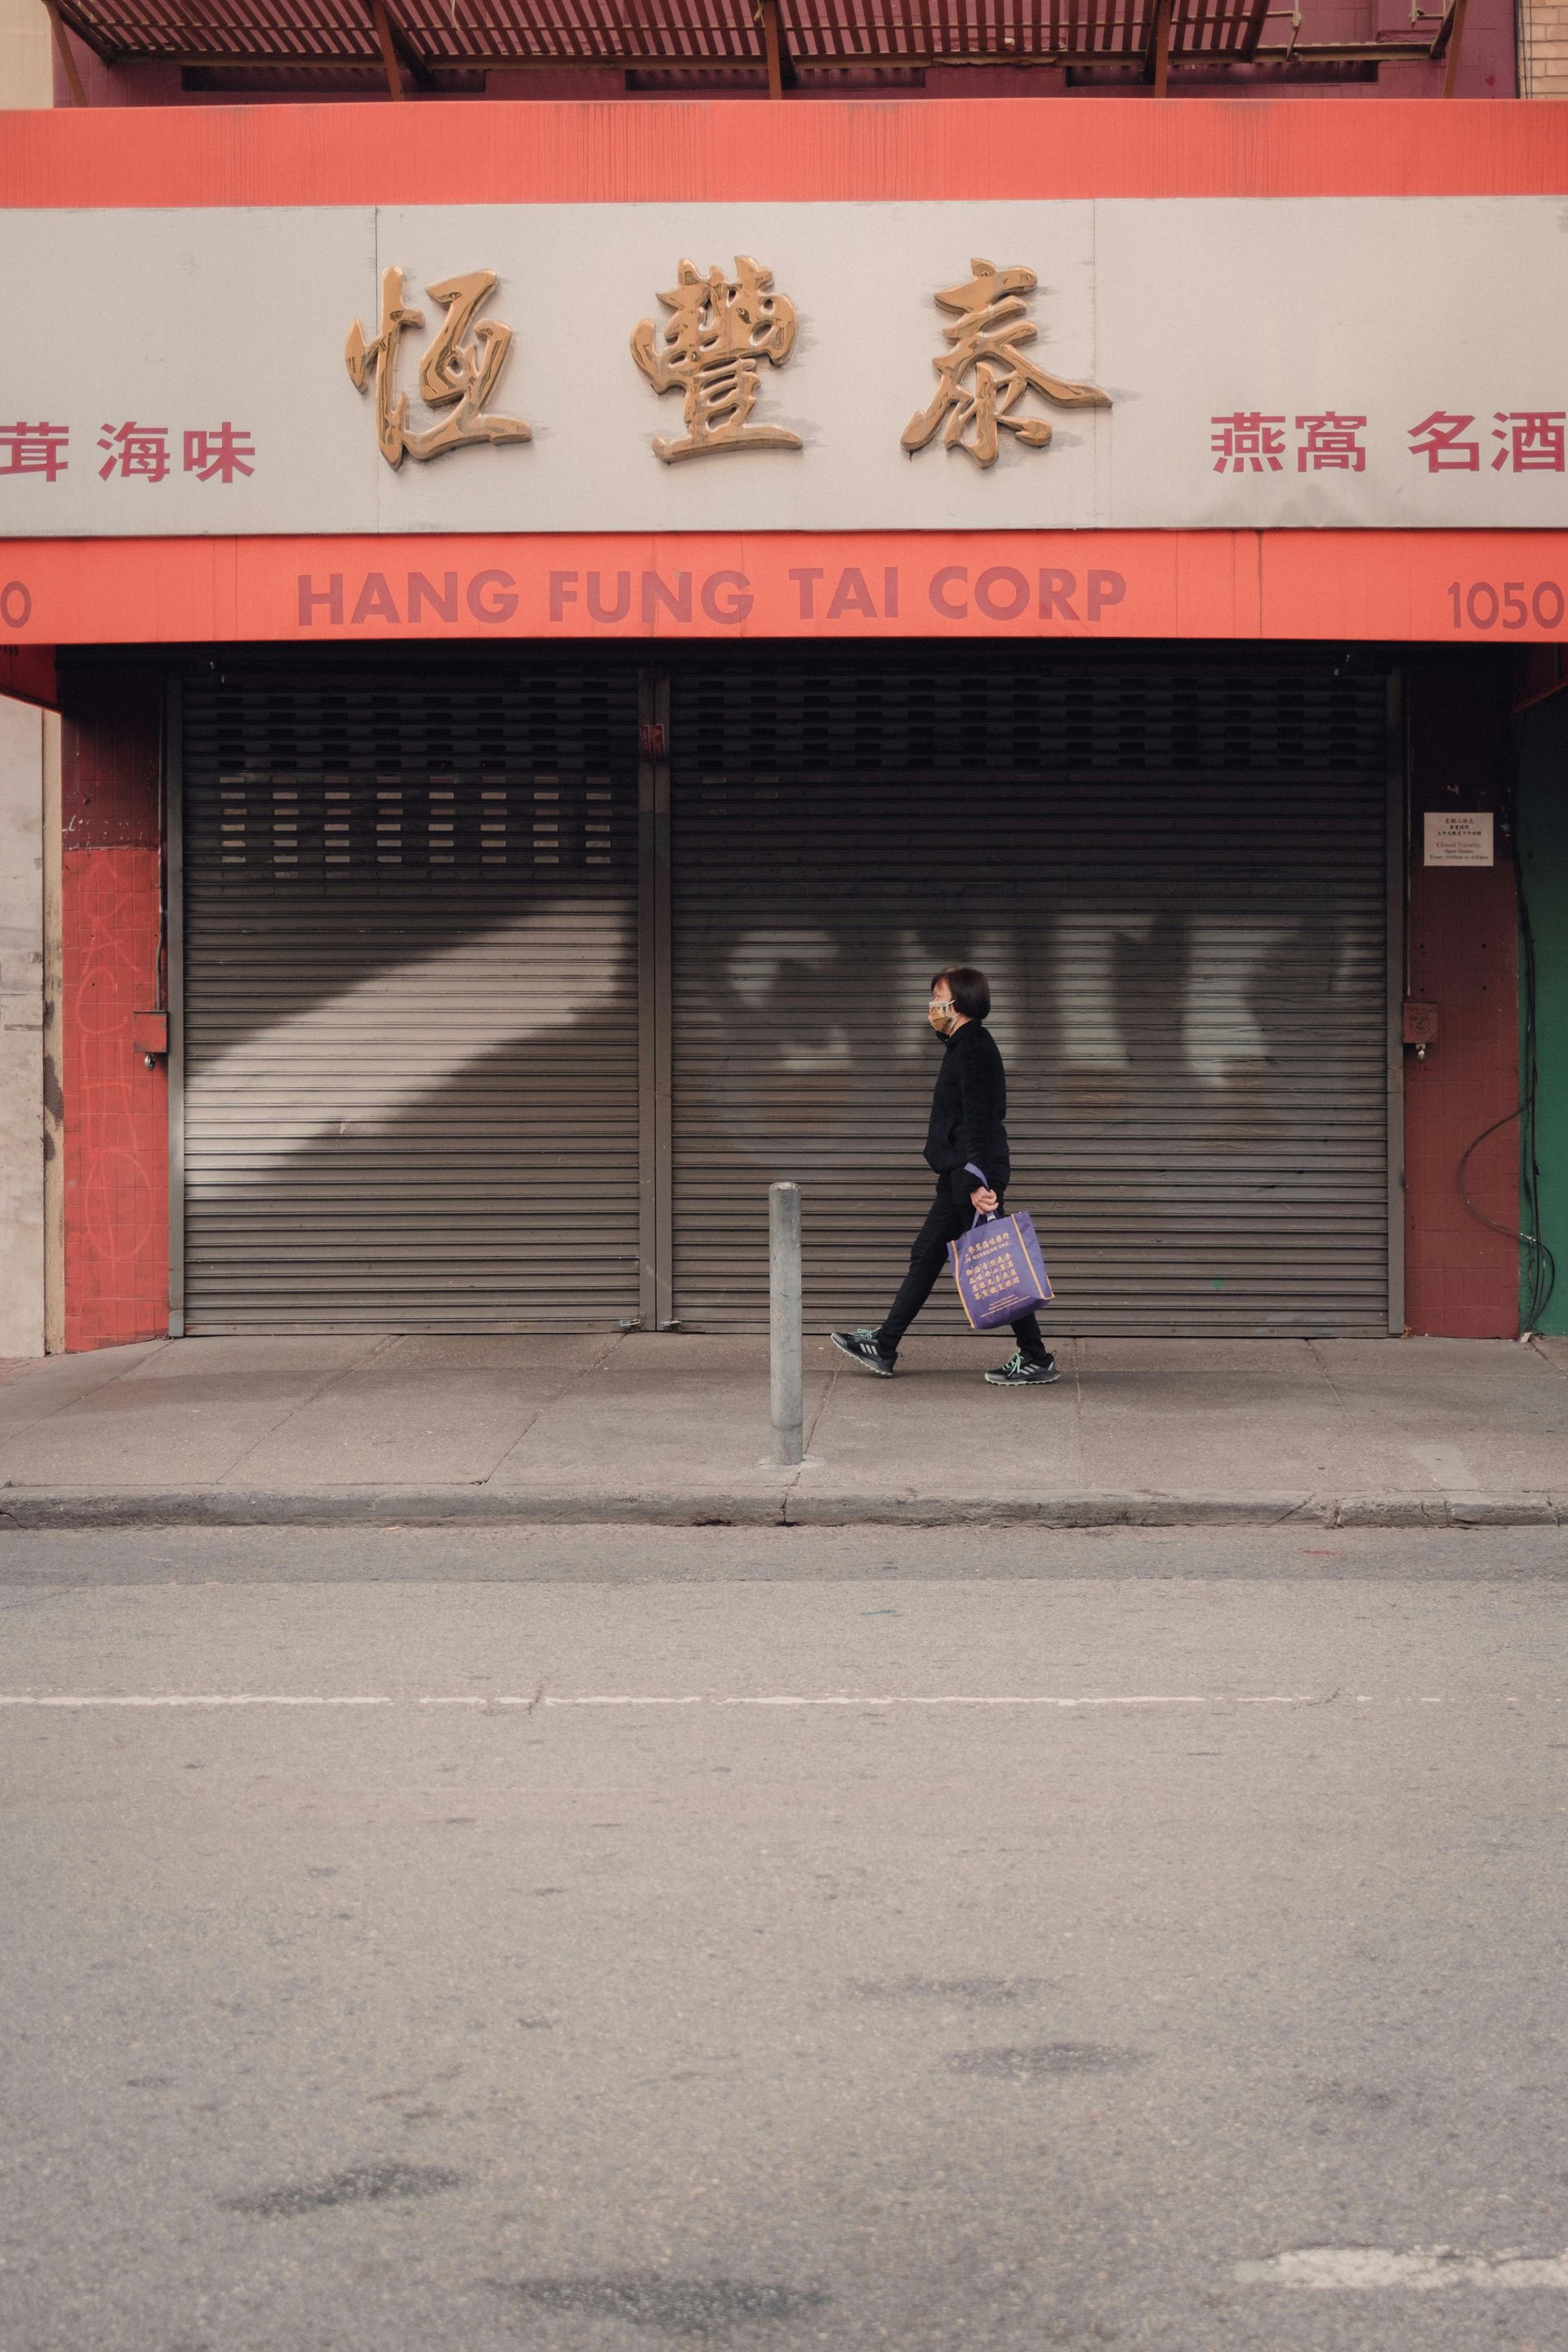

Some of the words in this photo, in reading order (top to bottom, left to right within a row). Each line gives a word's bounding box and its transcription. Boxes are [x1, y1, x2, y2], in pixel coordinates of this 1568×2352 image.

[297, 569, 520, 626] HANG
[549, 570, 754, 626] FUNG
[788, 565, 898, 620] TAI
[928, 565, 1127, 622] CORP
[1447, 581, 1566, 630] 1050
